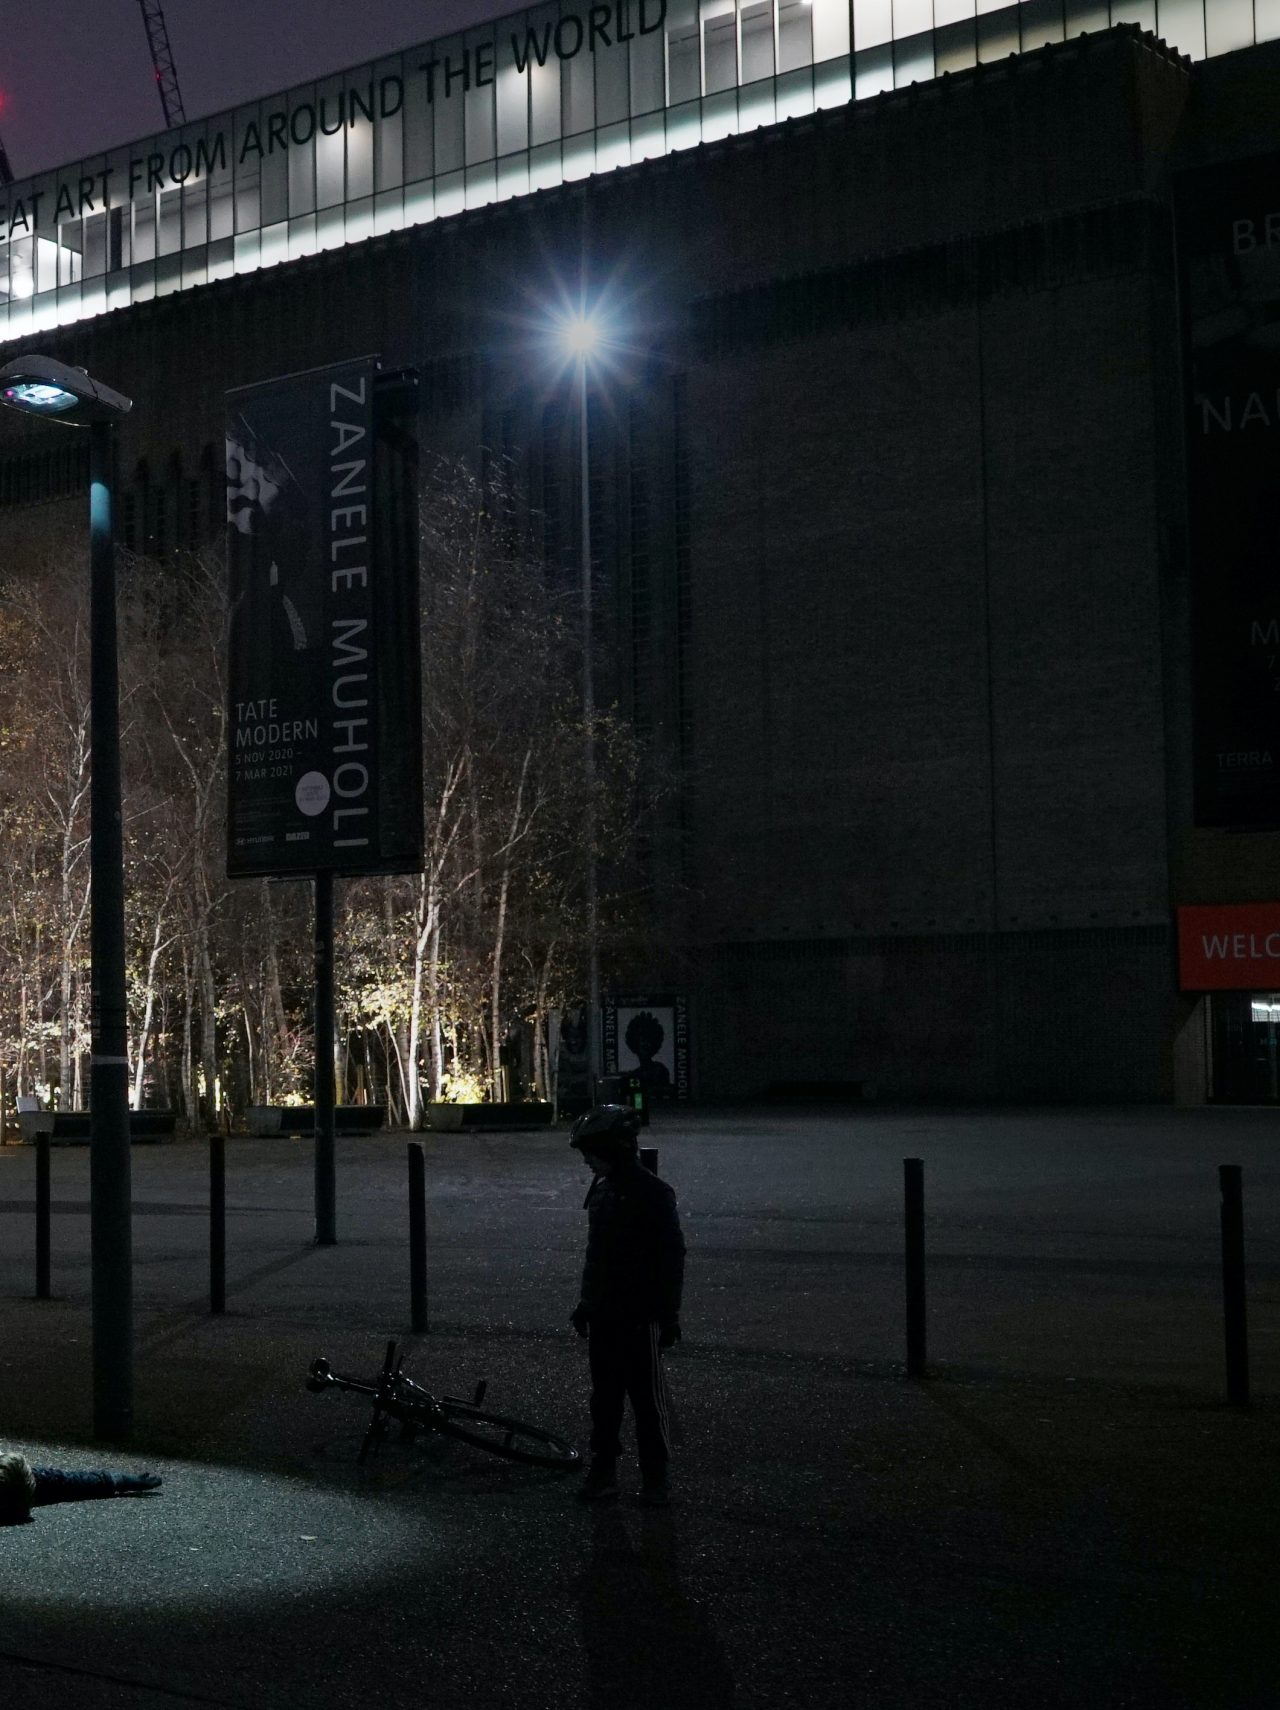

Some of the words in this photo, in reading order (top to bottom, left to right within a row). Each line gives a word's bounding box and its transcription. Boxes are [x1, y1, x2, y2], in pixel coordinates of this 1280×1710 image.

[53, 168, 114, 223] ART
[129, 133, 226, 198] FROM
[239, 75, 403, 163] AROUND
[419, 42, 493, 103] THE
[511, 0, 667, 73] WORLD
[1200, 388, 1280, 434] NA
[330, 377, 368, 593] ZANELE
[235, 698, 278, 722] TATE
[235, 718, 319, 748] MODERN
[331, 618, 370, 848] MUHOLI
[235, 754, 242, 765] 5
[244, 751, 267, 763] NOV
[269, 748, 294, 761] 2020
[235, 770, 241, 782] 7
[244, 767, 267, 781] MAR
[270, 765, 293, 778] 2021
[1216, 751, 1273, 769] TERRA
[605, 997, 615, 1044] ZANELE
[676, 996, 687, 1044] ZANELE
[677, 1048, 688, 1099] MUHOLI
